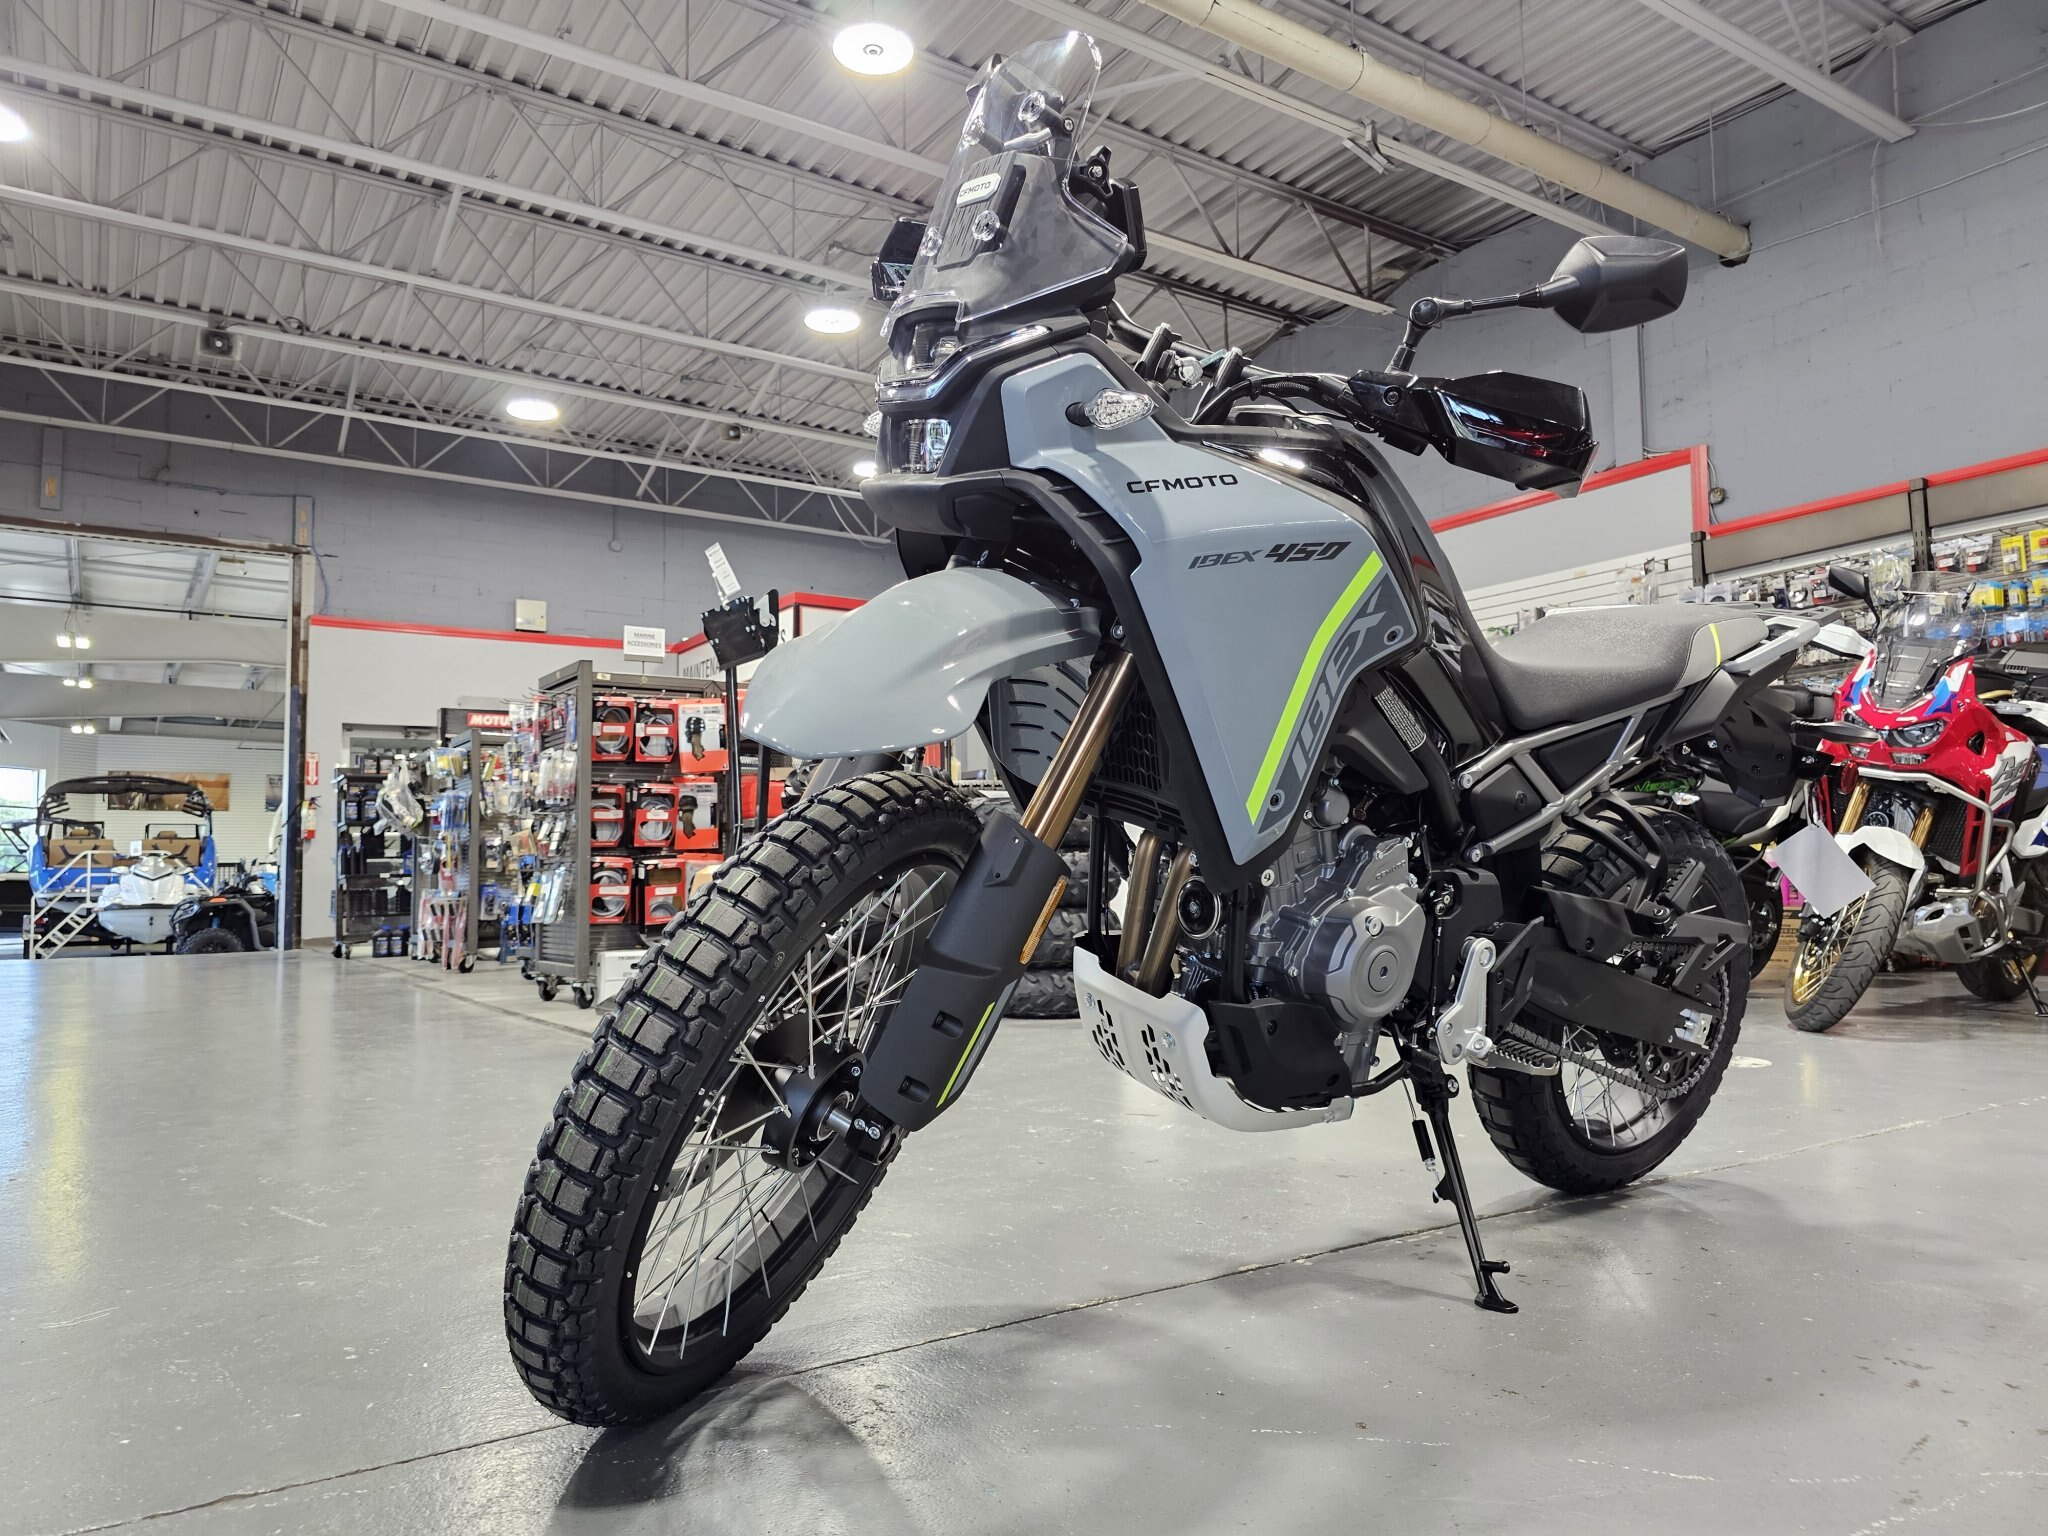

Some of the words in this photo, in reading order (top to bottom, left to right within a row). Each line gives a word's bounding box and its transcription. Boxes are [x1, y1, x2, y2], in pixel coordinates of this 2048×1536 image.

[959, 181, 991, 197] CFMOTO
[1126, 474, 1239, 494] CFMOTO
[1187, 549, 1263, 570] IBEX
[1264, 541, 1352, 563] 450
[633, 631, 656, 640] MARINE
[627, 640, 662, 649] ACCESSORIES
[1291, 585, 1387, 782] IBEX
[469, 714, 510, 726] MOTU
